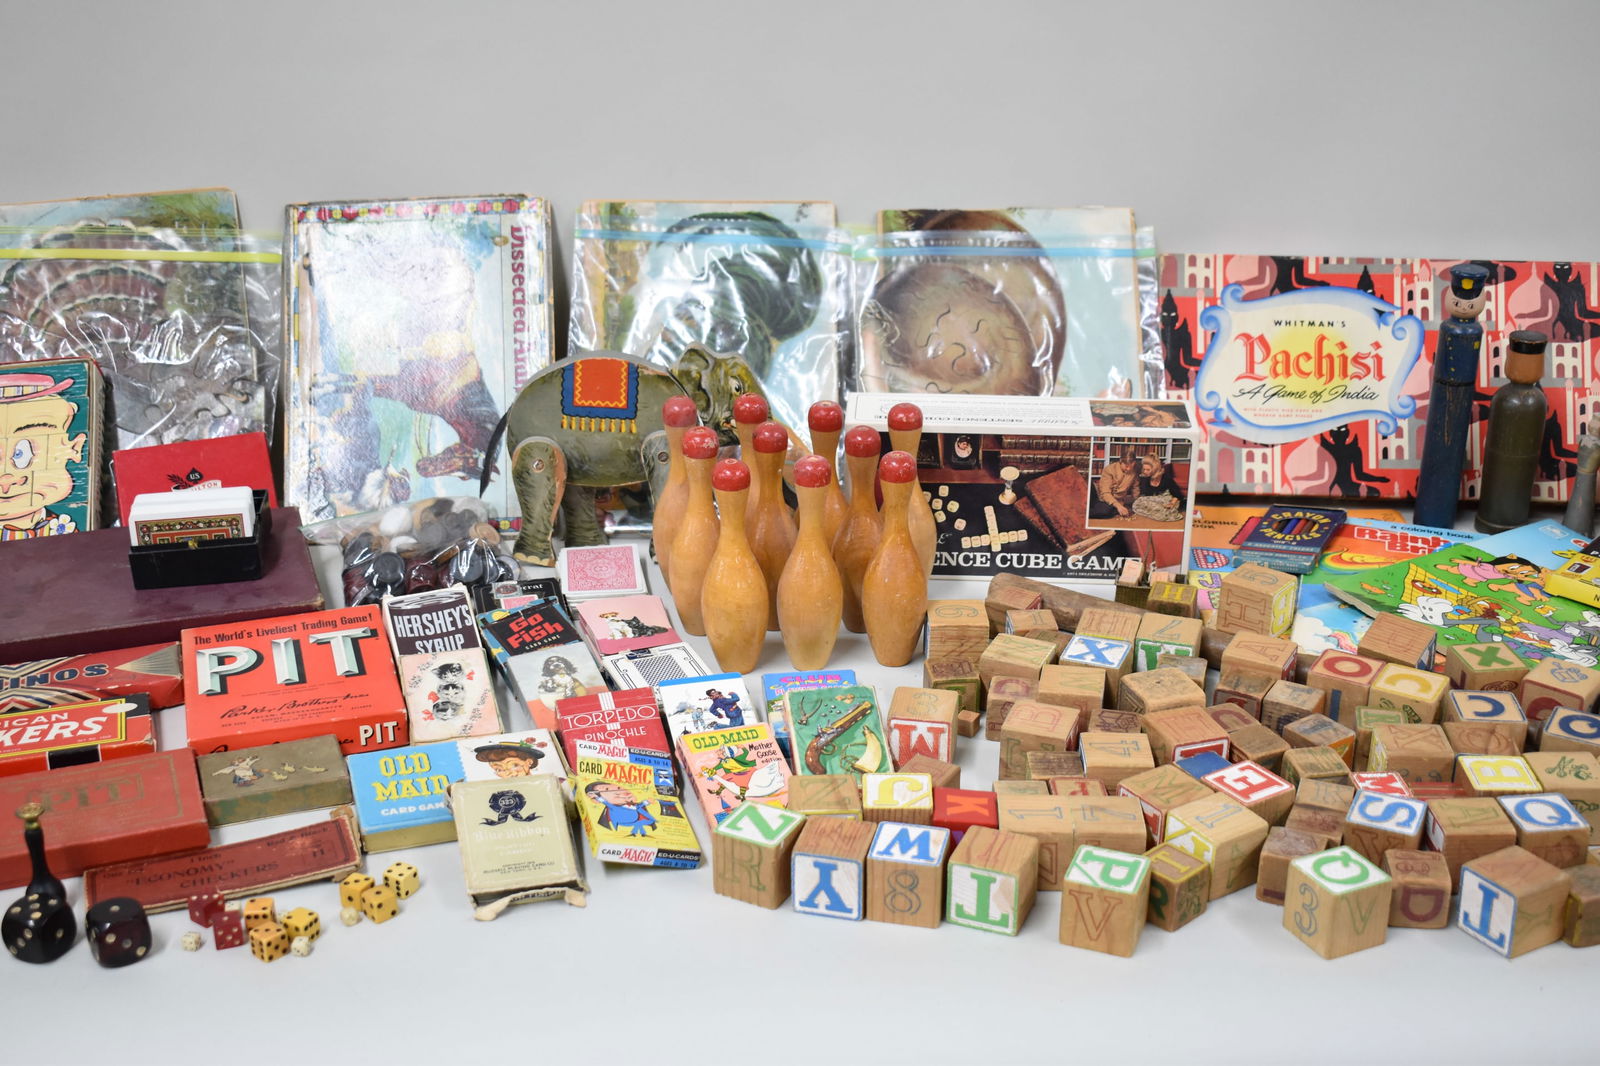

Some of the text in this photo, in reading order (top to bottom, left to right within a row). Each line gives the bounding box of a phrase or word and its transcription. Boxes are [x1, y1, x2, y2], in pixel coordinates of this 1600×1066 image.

[1274, 320, 1346, 328] WHITMAN'S
[1234, 332, 1386, 385] Pachisi
[1232, 384, 1380, 404] A Game of India
[1270, 511, 1332, 524] CRAYON
[1259, 528, 1322, 541] PENCILS
[1400, 525, 1444, 536] coloring
[1446, 530, 1474, 540] book
[932, 552, 991, 568] ENCE
[995, 553, 1062, 569] CUBE
[1192, 548, 1229, 568] D
[194, 612, 373, 646] The World's Liveliest Trading Game!
[393, 604, 473, 638] HERSHEY'S
[415, 634, 465, 654] SYRUP
[507, 622, 564, 649] Fish
[525, 634, 561, 650] CARD GAME
[196, 626, 379, 697] PIT
[1068, 638, 1124, 666] X
[1464, 646, 1514, 667] X
[0, 664, 110, 690] INOS
[1324, 656, 1372, 678] O
[0, 712, 69, 728] ICAN
[564, 705, 656, 729] TORPEDO
[358, 720, 398, 746] PIT
[584, 726, 646, 742] PINOCHLE
[693, 728, 760, 750] OLD MAID
[598, 744, 628, 759] MAGIC
[748, 742, 774, 752] Mother
[756, 750, 778, 758] Goose
[378, 750, 432, 778] OLD
[579, 761, 653, 785] CARD MAGIC
[1470, 760, 1532, 785] B
[372, 774, 449, 802] MAID
[1213, 764, 1284, 800] E
[41, 778, 134, 812] PIT
[946, 794, 990, 817] K
[380, 802, 447, 816] CARD GAM
[1358, 795, 1417, 828] S
[1514, 798, 1580, 827] Q
[602, 848, 655, 862] CARD MAGIC
[1313, 850, 1370, 885] Q
[180, 862, 279, 890] CHECKERS
[1081, 850, 1142, 887] P
[800, 860, 854, 914] Y
[884, 869, 922, 916] 8
[955, 872, 1010, 928] T
[1294, 882, 1319, 937] 3
[1068, 890, 1122, 942] V
[1464, 882, 1506, 949] T
